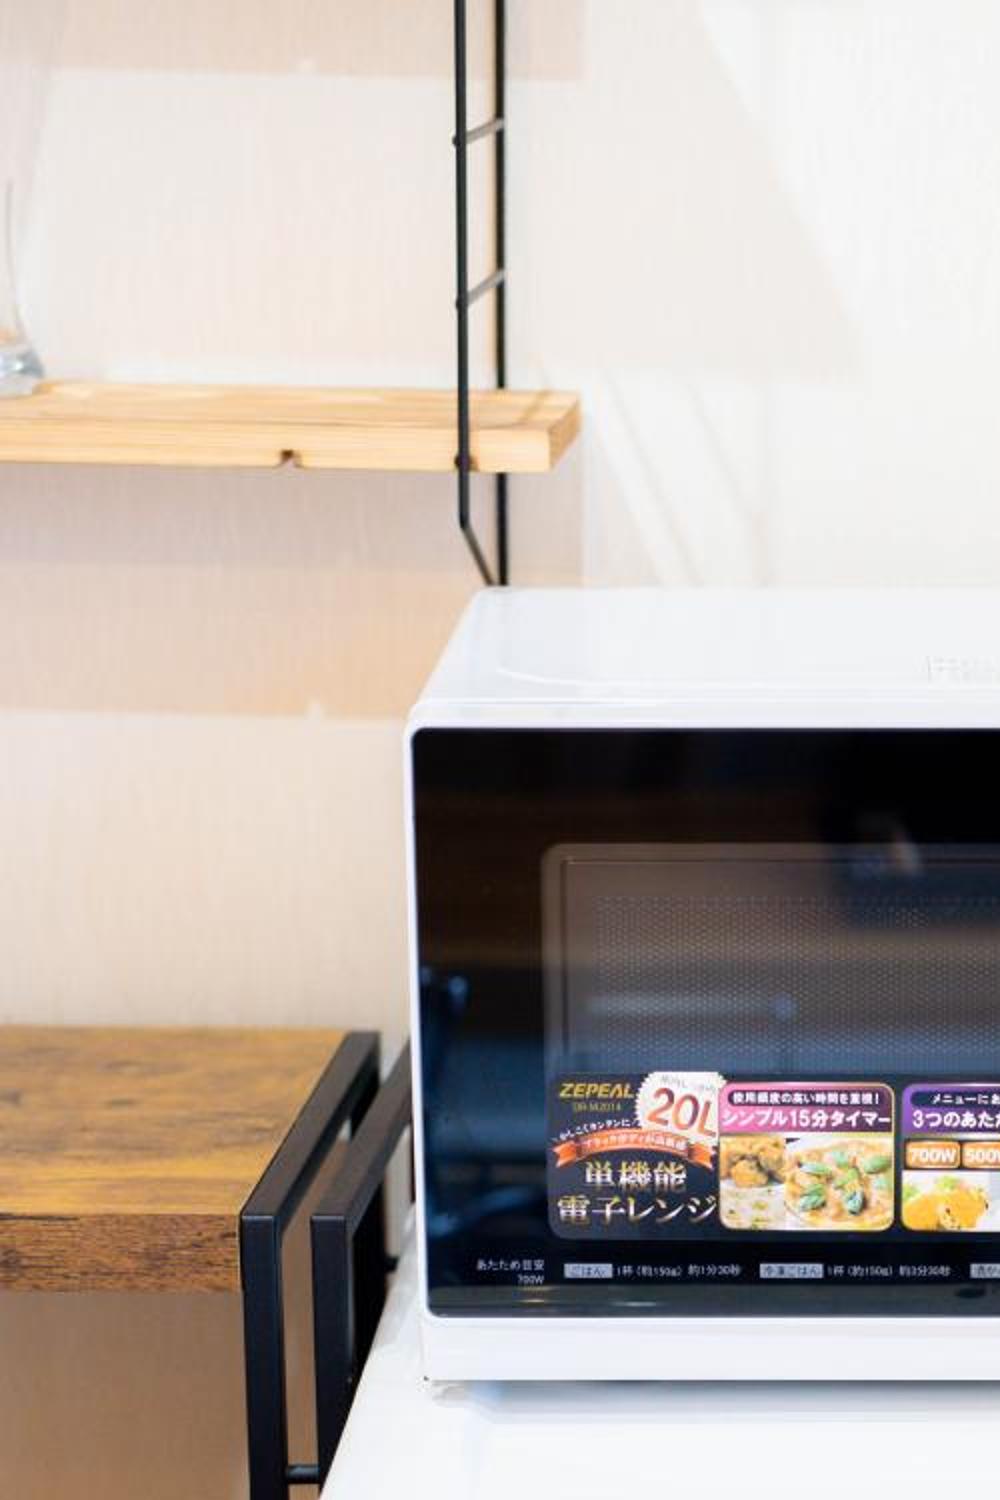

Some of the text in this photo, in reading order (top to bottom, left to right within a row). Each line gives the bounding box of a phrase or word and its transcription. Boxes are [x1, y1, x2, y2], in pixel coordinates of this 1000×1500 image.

[559, 1083, 634, 1098] ZEPEAL
[647, 1087, 717, 1137] 20L
[722, 1109, 891, 1127] シンプル15分タイマー
[911, 1148, 957, 1163] 700W
[558, 1195, 717, 1223] 電子レンジ
